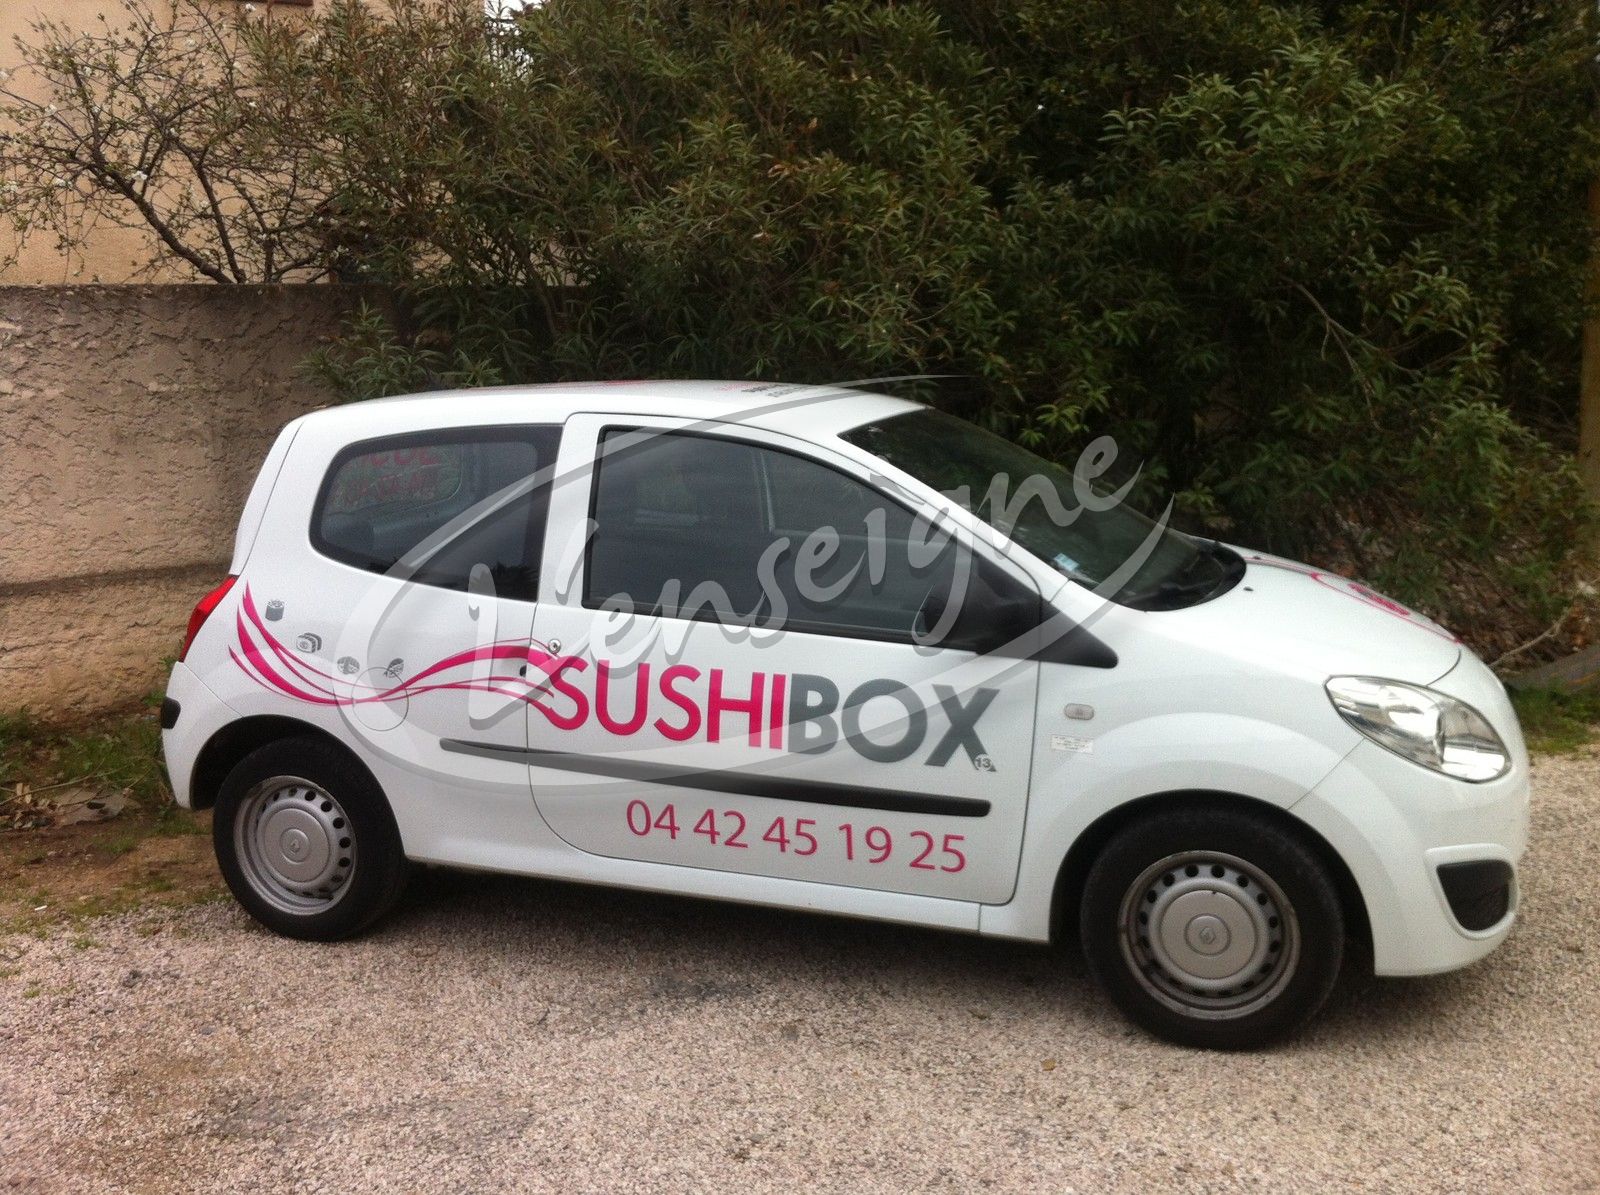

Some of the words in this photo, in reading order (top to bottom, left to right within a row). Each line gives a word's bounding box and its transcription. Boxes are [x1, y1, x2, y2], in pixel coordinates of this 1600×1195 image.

[626, 799, 681, 840] 04
[693, 808, 749, 849] 42
[762, 816, 818, 856] 45
[838, 823, 892, 864] 19
[909, 830, 966, 873] 25
